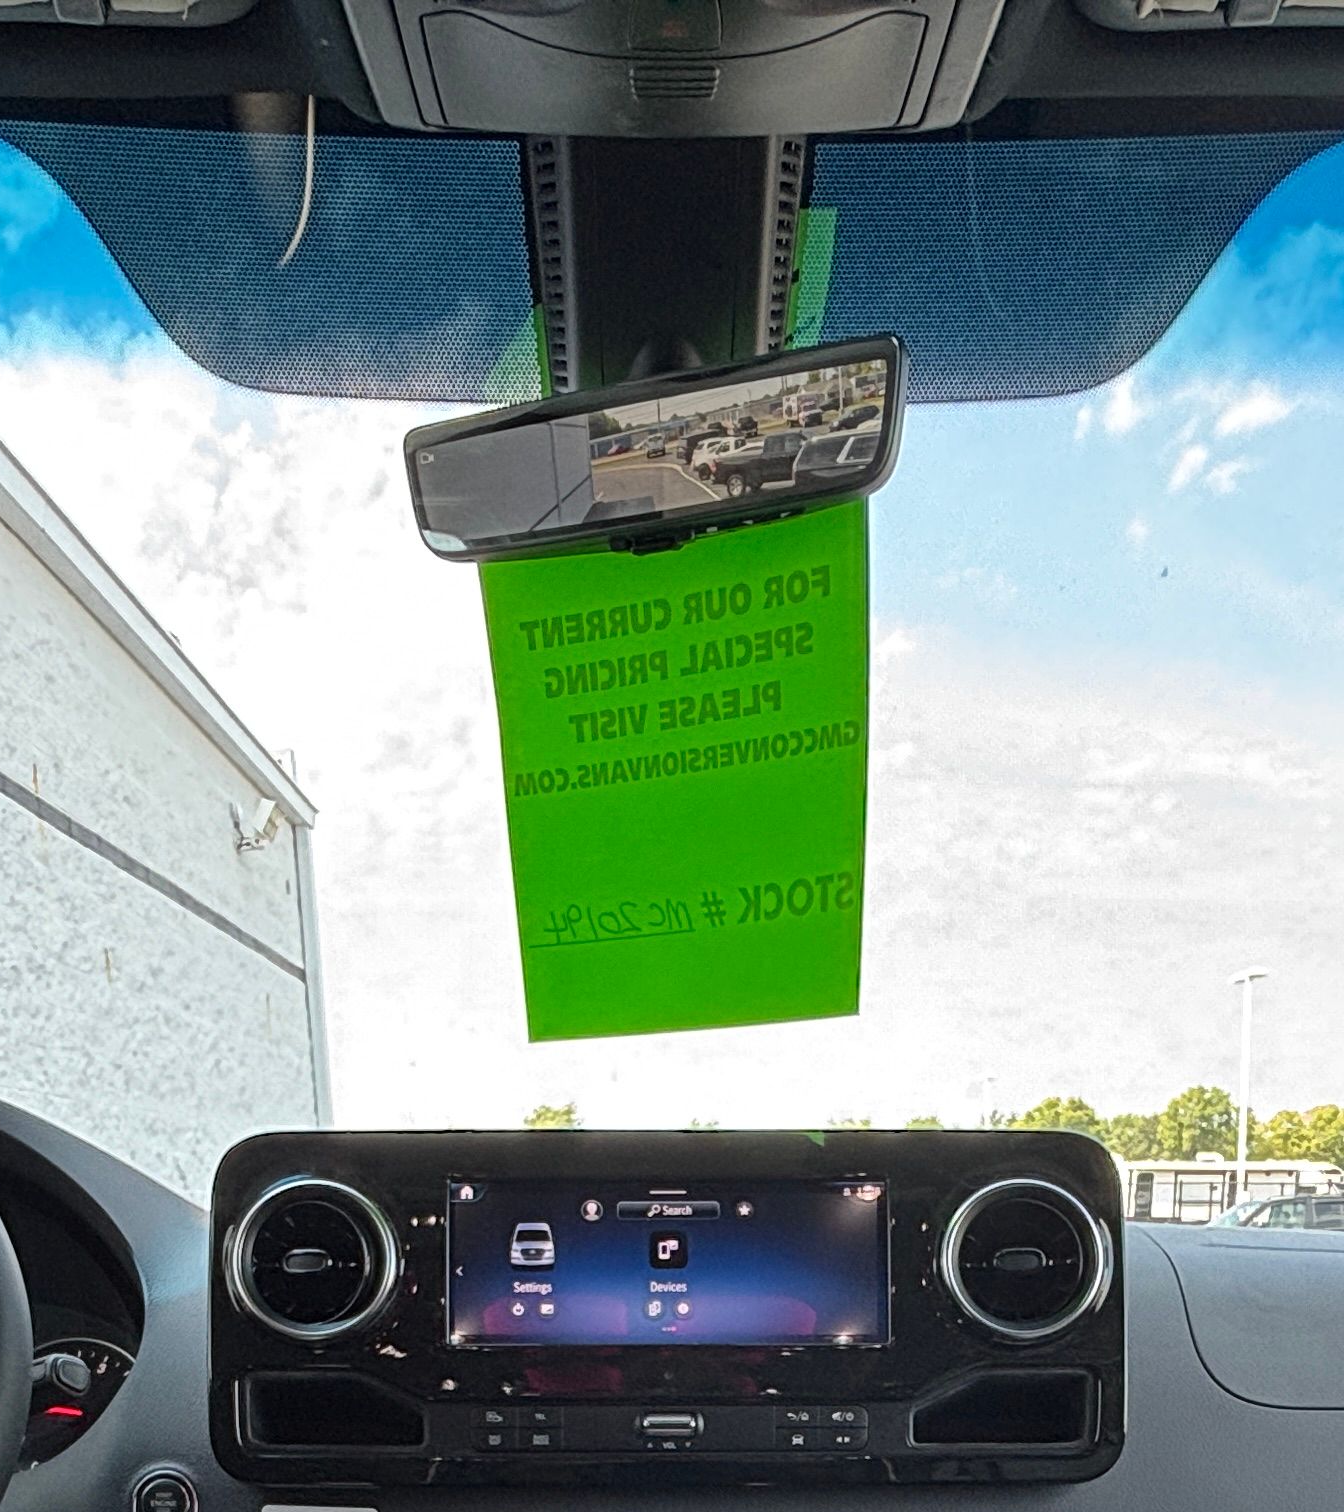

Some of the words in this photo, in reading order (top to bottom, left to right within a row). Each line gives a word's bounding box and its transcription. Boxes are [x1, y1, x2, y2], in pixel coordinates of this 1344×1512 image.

[662, 1204, 693, 1218] Search
[512, 1281, 553, 1295] Settings
[650, 1281, 687, 1294] Devices
